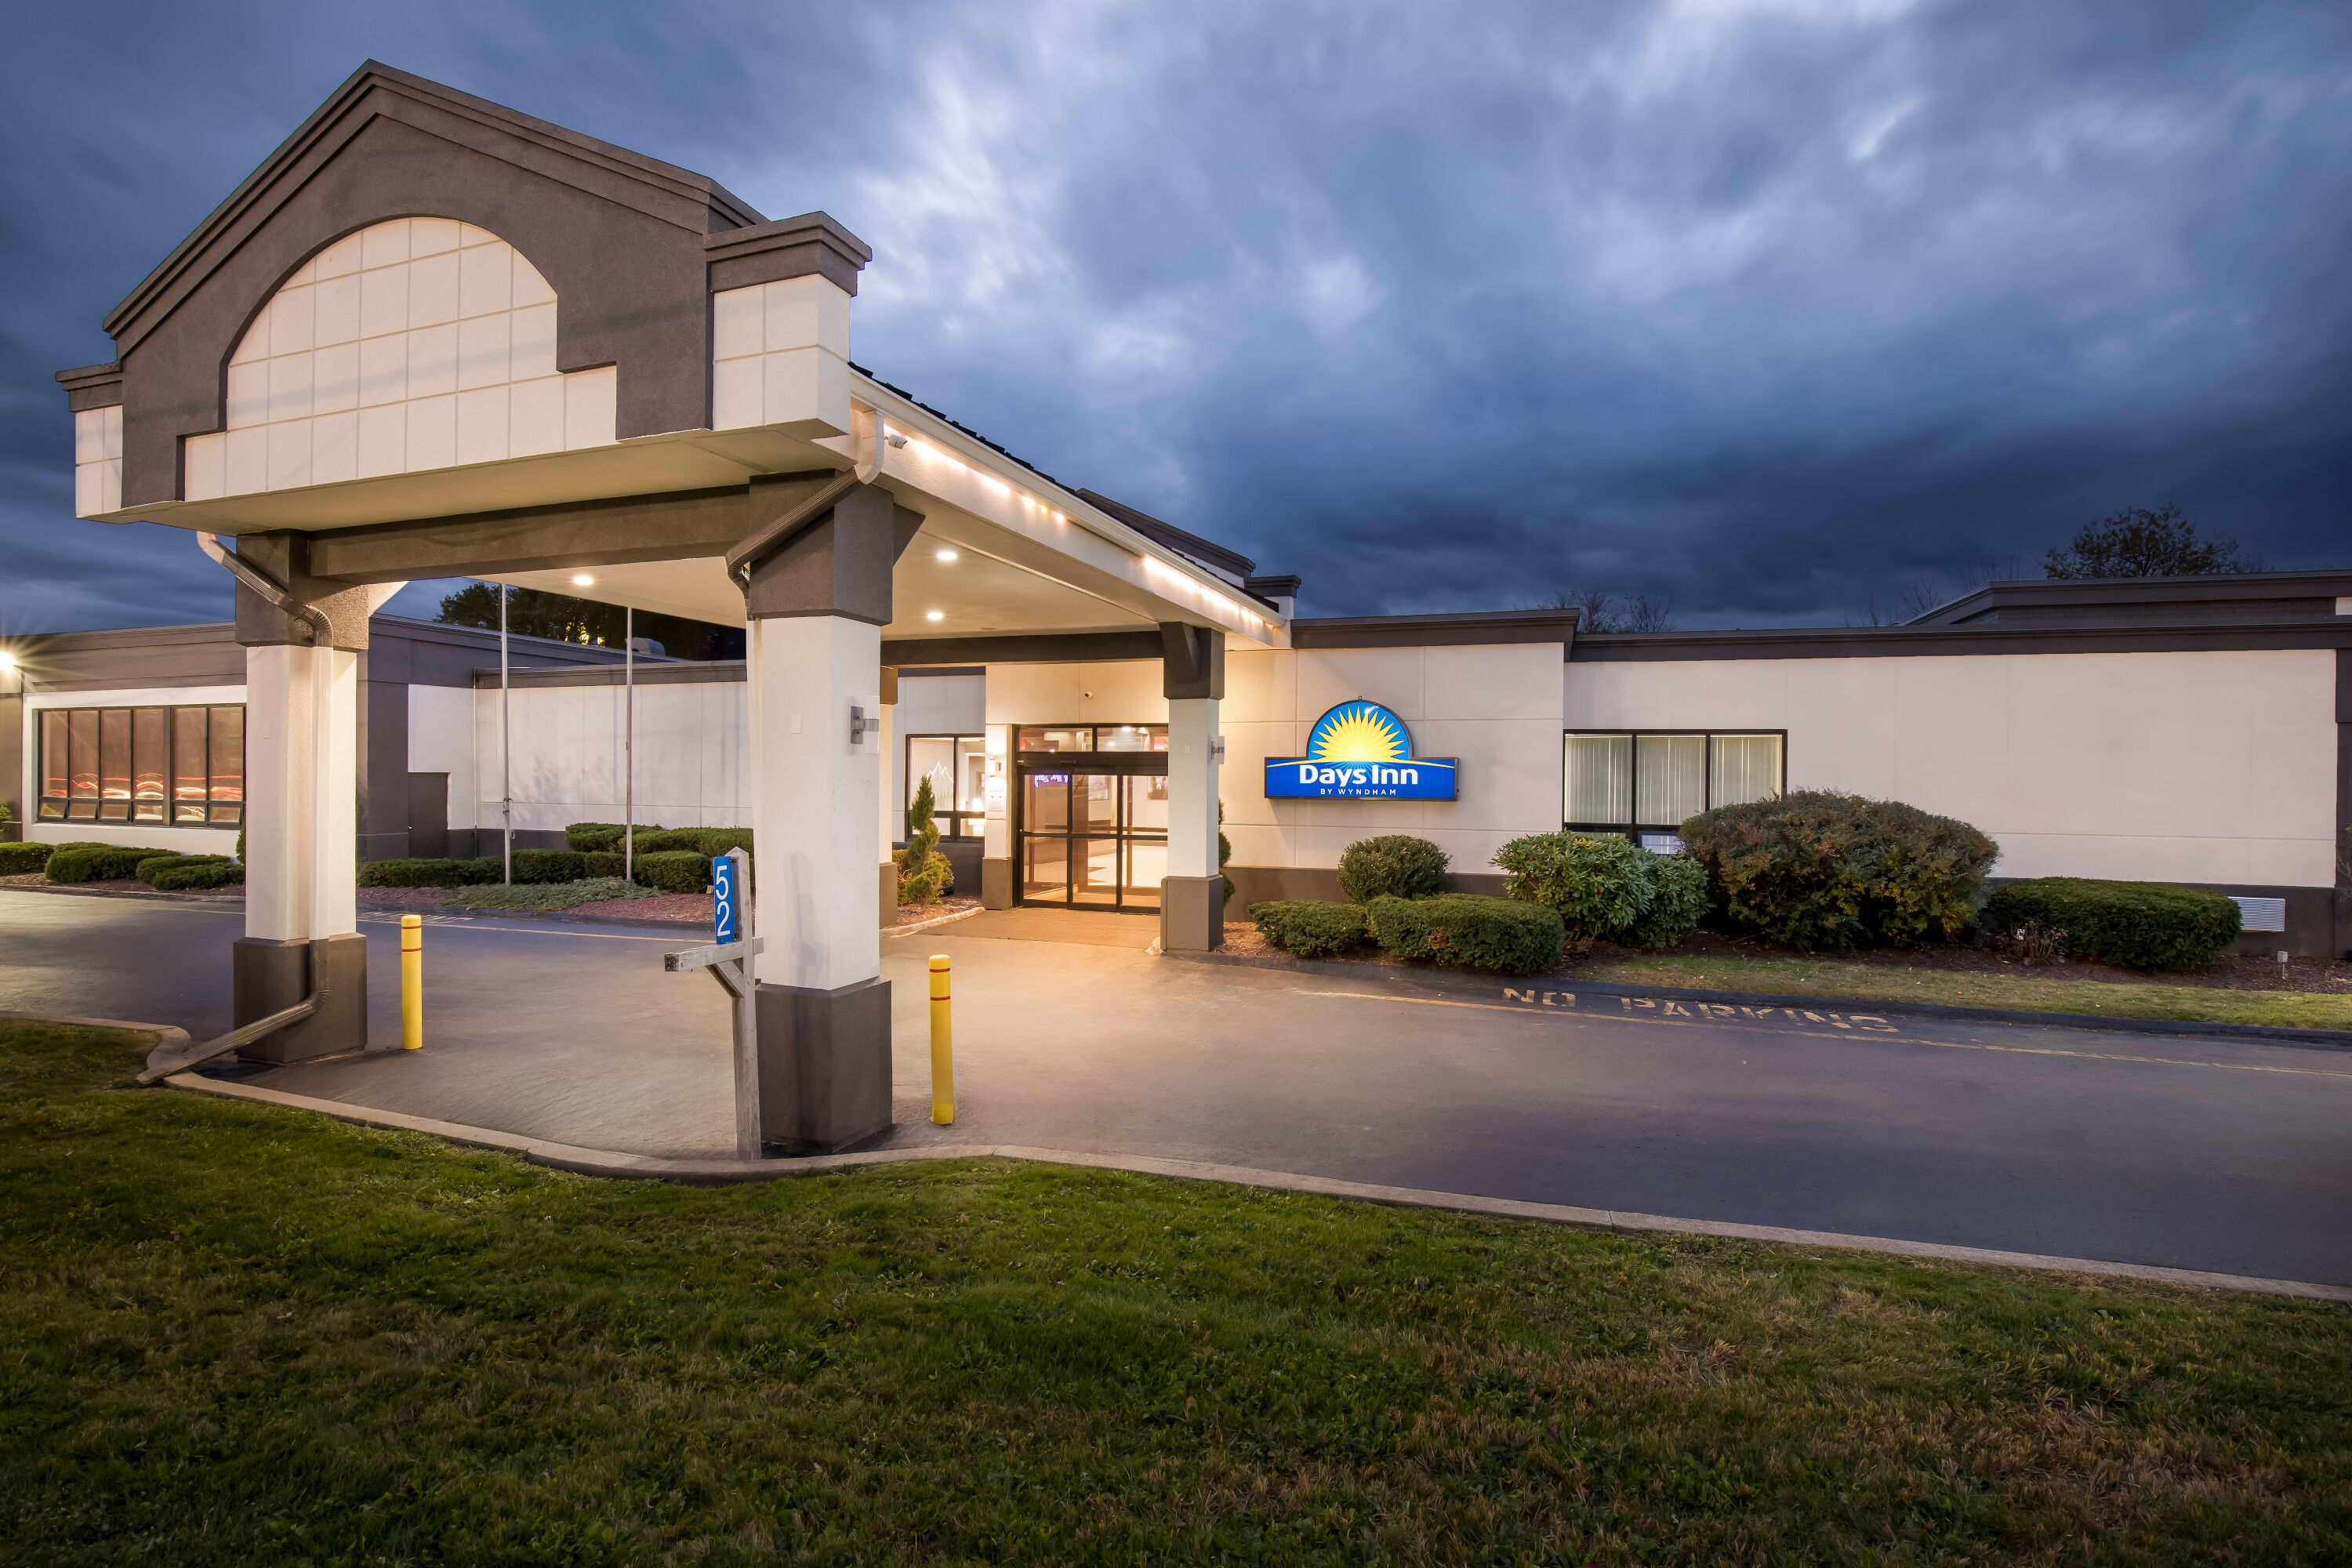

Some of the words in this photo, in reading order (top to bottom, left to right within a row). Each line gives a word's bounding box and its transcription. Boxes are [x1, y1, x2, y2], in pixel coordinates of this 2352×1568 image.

[1299, 764, 1367, 787] Days
[1371, 764, 1418, 785] Inn
[715, 865, 731, 937] 52
[1501, 987, 1577, 1008] NO
[1621, 997, 1900, 1033] PARKING
